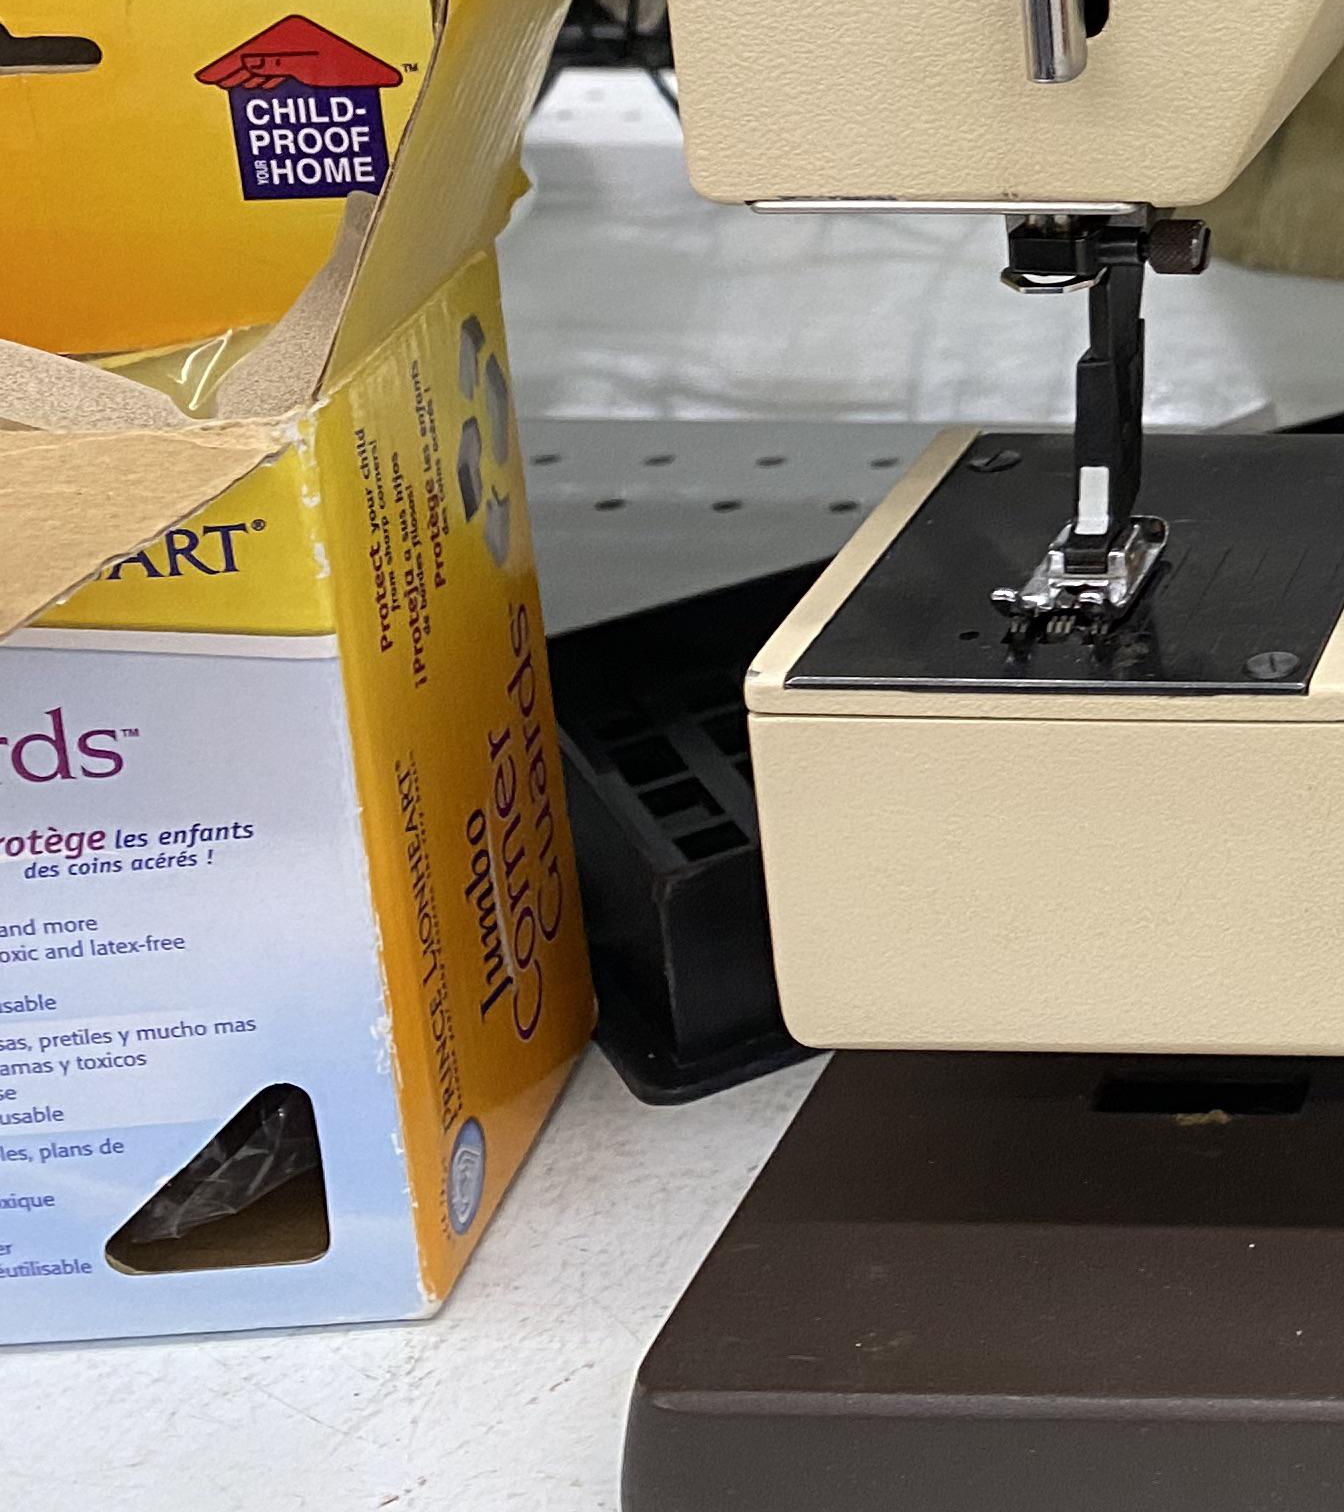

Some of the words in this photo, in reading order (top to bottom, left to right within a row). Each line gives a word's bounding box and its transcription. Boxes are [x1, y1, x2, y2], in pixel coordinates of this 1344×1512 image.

[246, 96, 367, 126] CHILD-
[249, 126, 370, 155] PROOF
[254, 160, 270, 185] YOUR
[270, 156, 376, 185] HOME
[365, 487, 380, 533] your
[369, 541, 394, 652] Protect
[0, 826, 106, 859] otège
[115, 829, 148, 849] les
[158, 821, 254, 848] enfants
[24, 862, 60, 879] des
[68, 857, 123, 876] coins
[131, 850, 198, 872] acérés
[488, 727, 543, 1040] Corner
[0, 919, 35, 937] and
[43, 918, 98, 934] more
[464, 808, 513, 1023] Jumbo
[45, 940, 84, 960] and
[90, 935, 186, 956] latex-free
[38, 1029, 112, 1053] pretiles
[118, 1030, 130, 1047] y
[136, 1022, 207, 1041] mucho
[214, 1018, 257, 1034] mas
[59, 1060, 70, 1076] y
[76, 1052, 147, 1072] toxicos
[39, 1142, 93, 1163] plans
[99, 1138, 124, 1154] de
